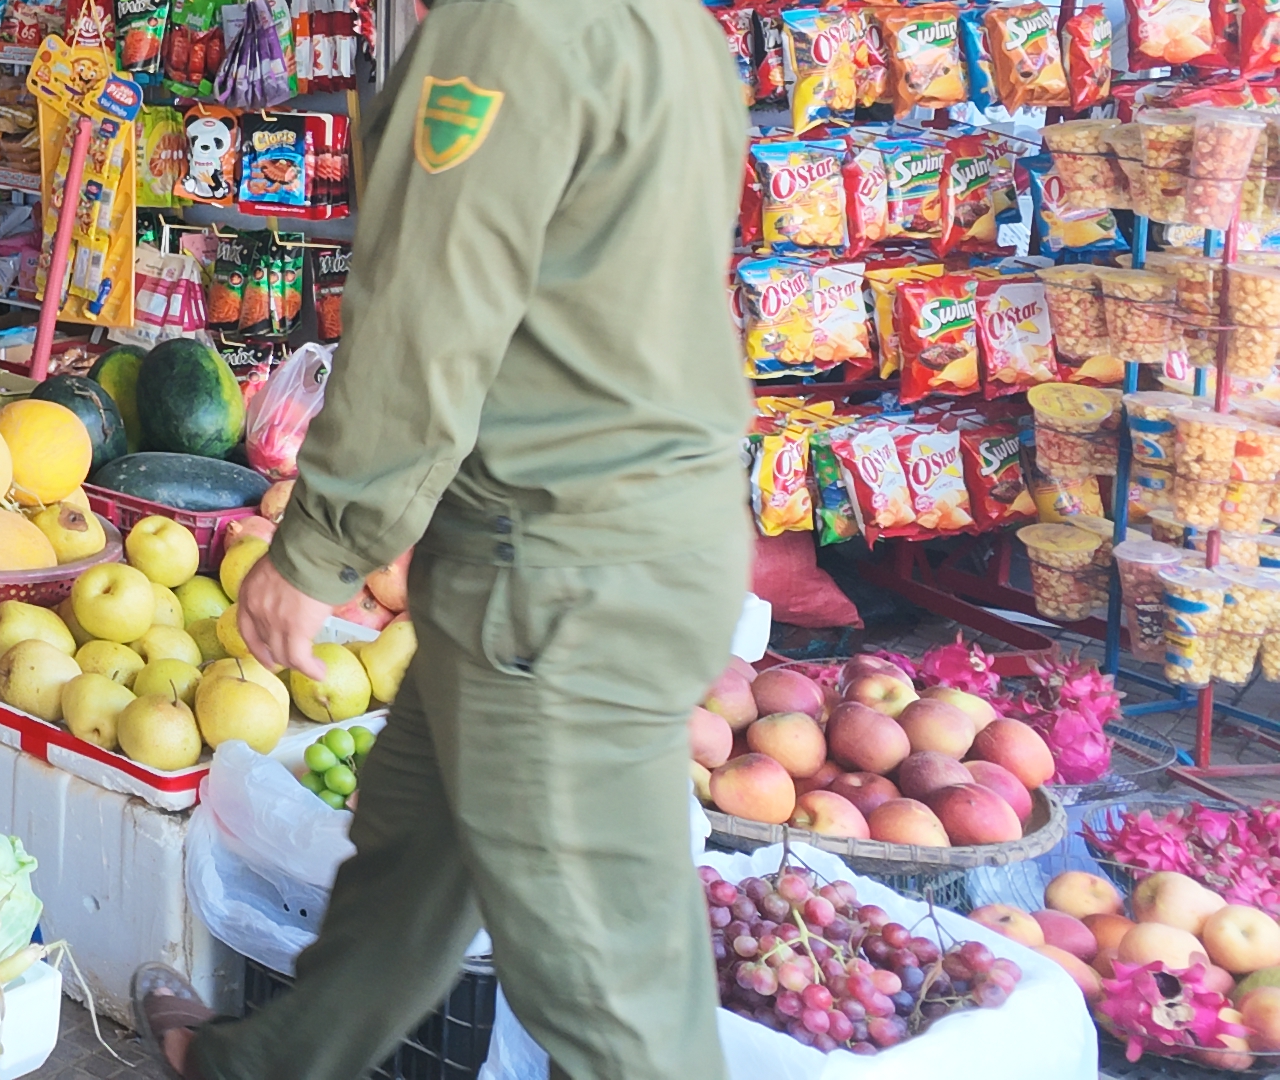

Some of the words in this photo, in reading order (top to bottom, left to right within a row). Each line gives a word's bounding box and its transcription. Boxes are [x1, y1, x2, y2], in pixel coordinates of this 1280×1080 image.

[21, 26, 36, 39] 65
[898, 19, 958, 57] Swing
[1006, 11, 1052, 50] Swing
[253, 130, 297, 152] Cloris
[771, 156, 835, 201] O'Star
[760, 272, 806, 318] O'Star
[813, 279, 858, 316] O'Star
[988, 299, 1039, 342] O'Star
[911, 446, 957, 487] O'Star
